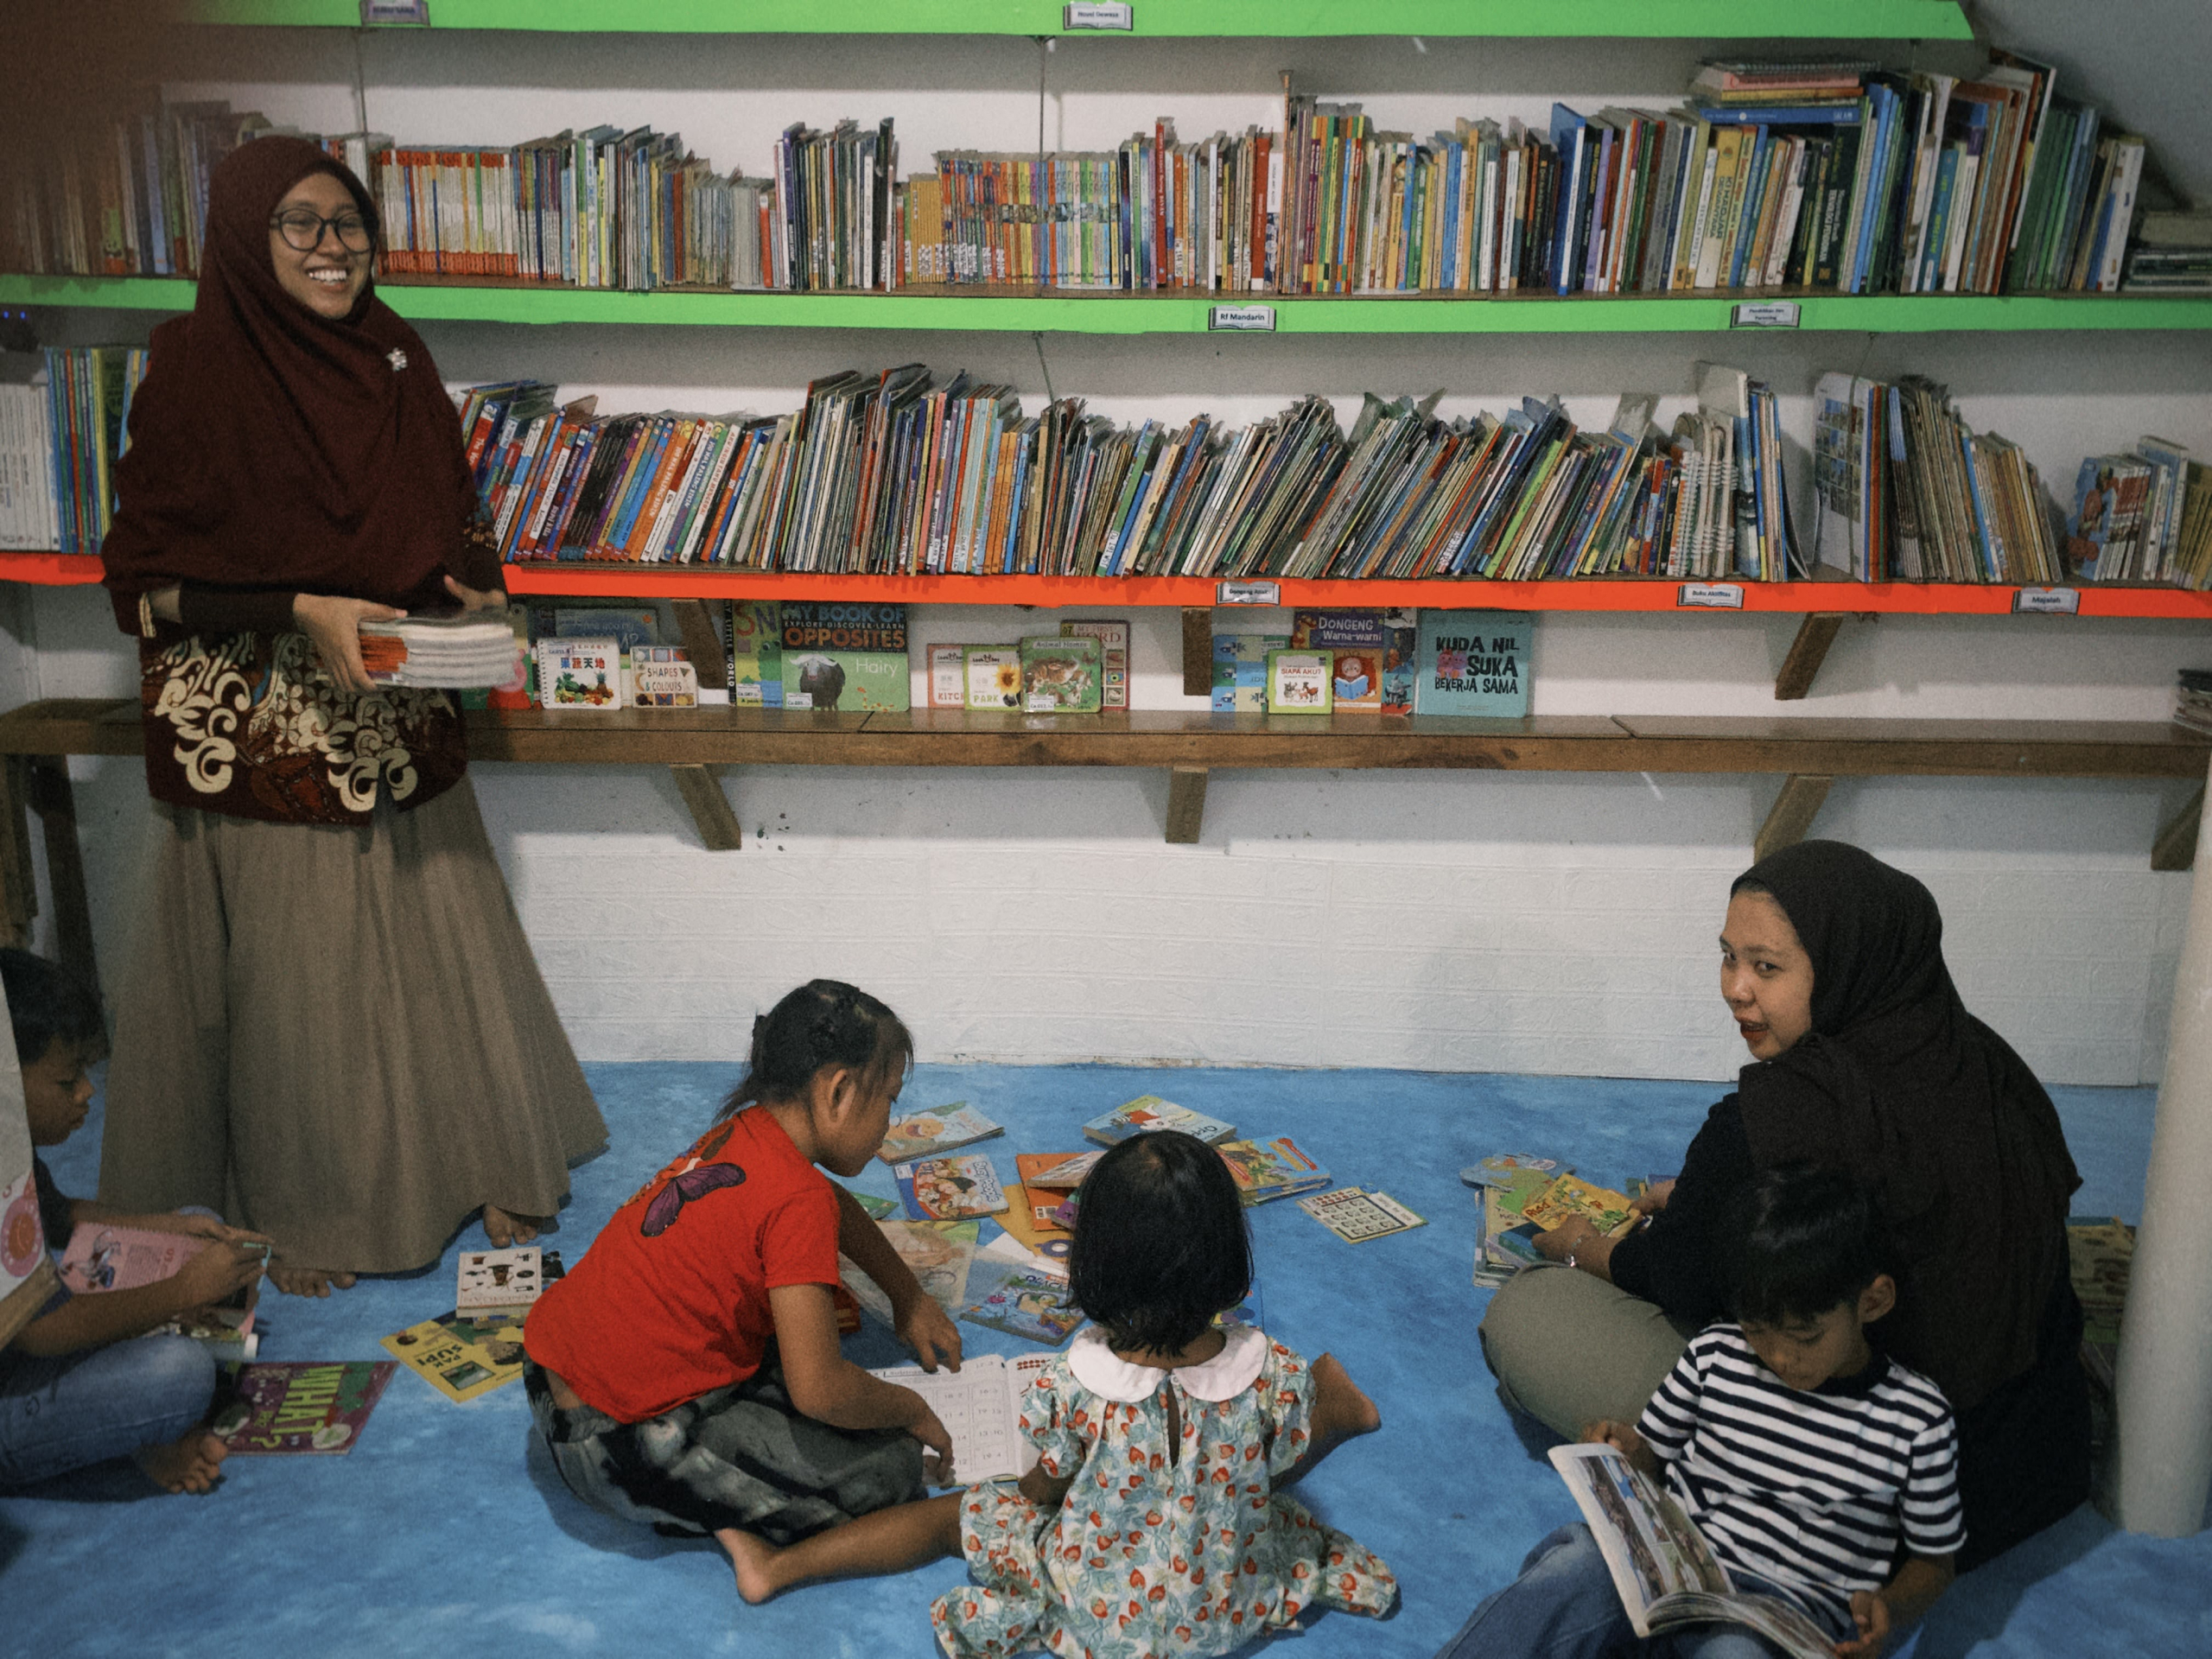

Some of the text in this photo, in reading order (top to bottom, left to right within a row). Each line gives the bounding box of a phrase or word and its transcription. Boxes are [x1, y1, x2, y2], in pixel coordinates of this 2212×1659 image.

[1708, 175, 1725, 238] DEWANTARA
[1715, 175, 1732, 239] KI HADJAR
[472, 435, 486, 451] The
[821, 606, 875, 622] BOOK
[879, 607, 906, 623] OF
[1318, 617, 1374, 631] DONGENG
[785, 627, 906, 648] OPPOSITES
[1322, 630, 1382, 642] Warna-warni
[1436, 636, 1520, 654] KUDA NIL
[560, 657, 606, 670] 果蔬天地
[647, 667, 678, 677] SHAPES
[855, 658, 899, 677] Hairy
[1465, 655, 1518, 677] SUKA
[652, 681, 683, 691] COLOURS
[1434, 677, 1518, 695] BEKERJA SAMA
[974, 695, 999, 703] PARK
[433, 1354, 461, 1369] PAK
[270, 1364, 346, 1435] WHAT
